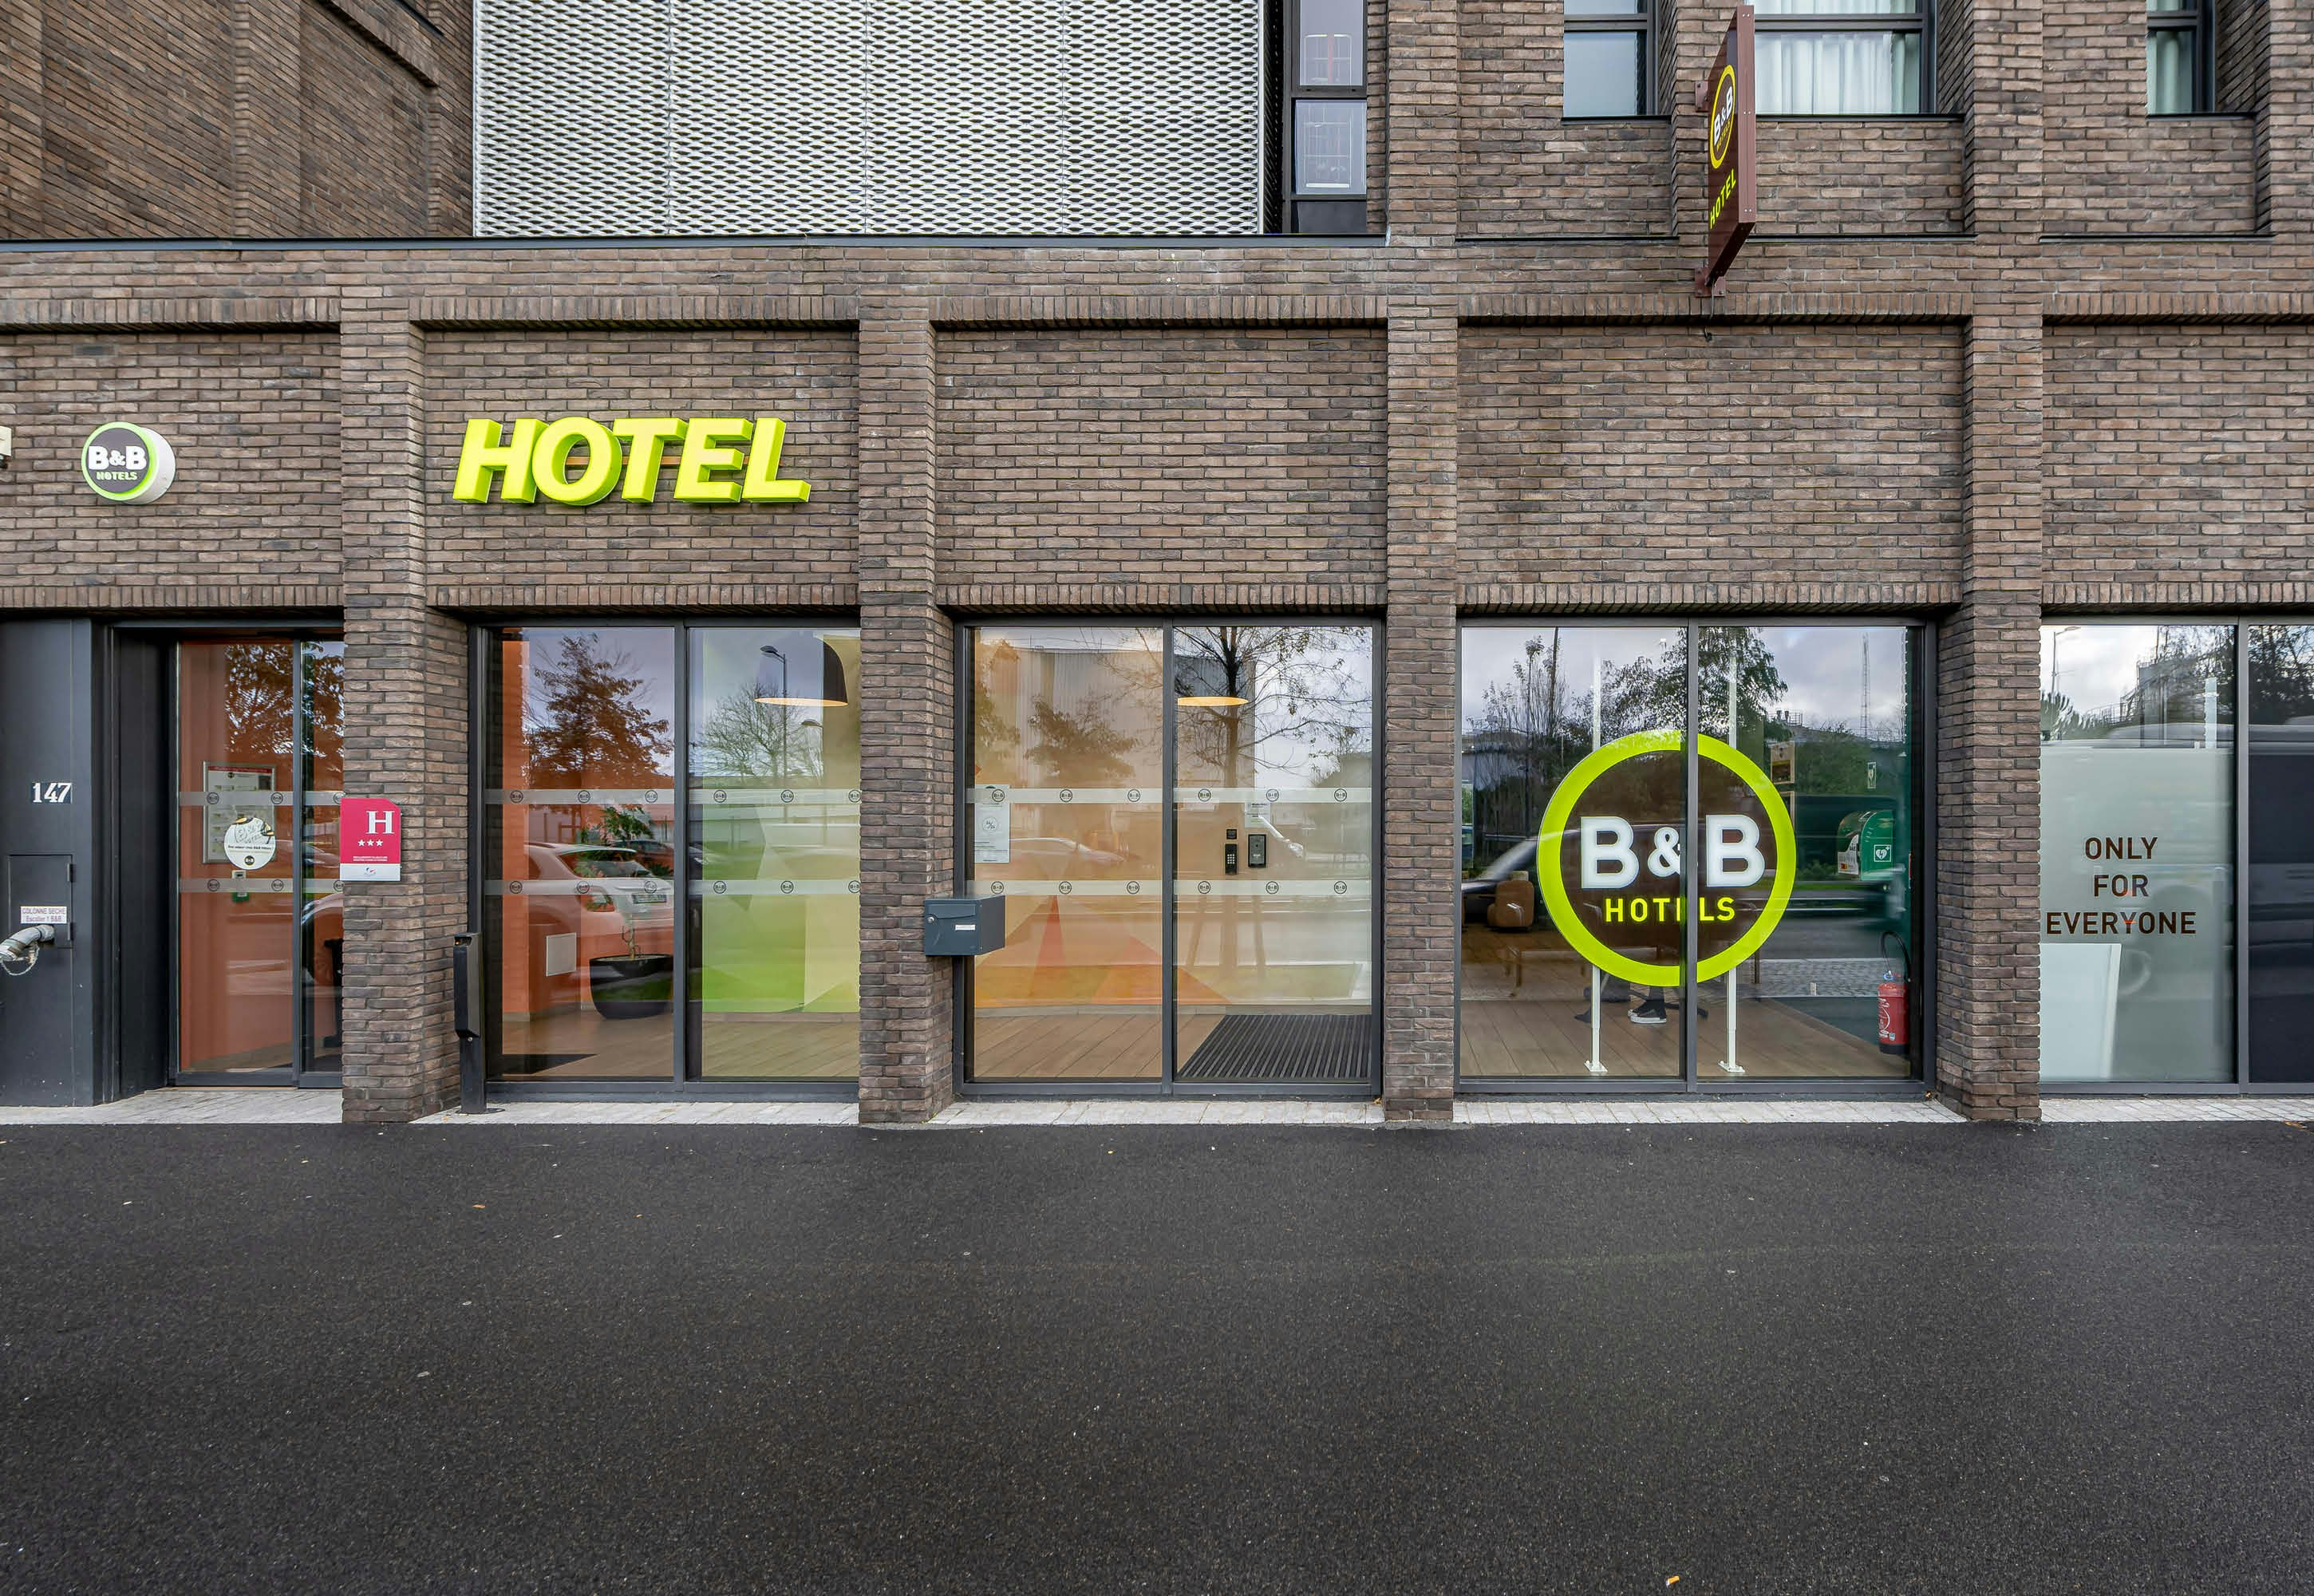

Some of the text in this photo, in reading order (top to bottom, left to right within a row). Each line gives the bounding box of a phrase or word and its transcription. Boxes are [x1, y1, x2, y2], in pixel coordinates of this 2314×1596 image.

[1714, 86, 1733, 146] B&B
[1710, 168, 1736, 230] HOTEL
[88, 445, 147, 470] B&B
[452, 417, 811, 506] HOTEL
[96, 471, 138, 480] HOTELS
[33, 782, 72, 803] 147
[365, 810, 396, 835] H
[1581, 814, 1766, 889] B&B
[2085, 837, 2158, 859] ONLY
[2094, 875, 2149, 897] FOR
[2047, 911, 2196, 934] EVERYONE
